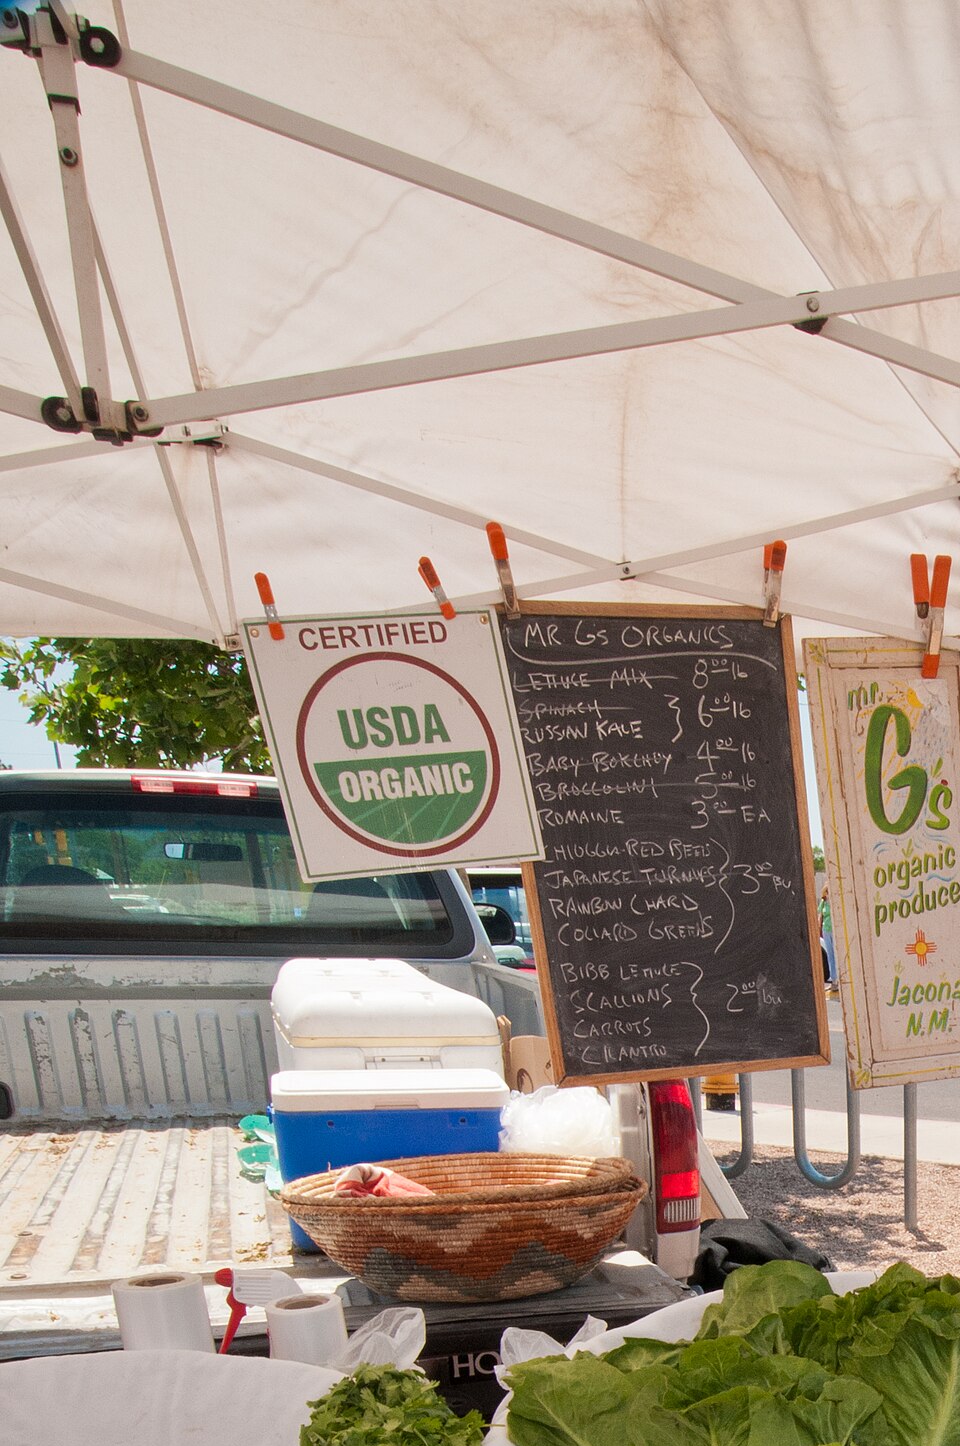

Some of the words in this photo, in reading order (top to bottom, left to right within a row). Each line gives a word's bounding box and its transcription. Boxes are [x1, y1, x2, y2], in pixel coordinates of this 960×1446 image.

[299, 621, 447, 650] CERTIFIED
[525, 623, 561, 648] MR
[621, 626, 734, 649] ORGANICS
[610, 667, 653, 689] MIX
[337, 703, 451, 750] USDA
[596, 720, 643, 741] KALE
[338, 762, 475, 803] ORGANIC
[537, 808, 625, 831] ROMAINE
[743, 805, 771, 824] EA
[544, 870, 632, 889] JAPANESE
[873, 844, 956, 890] organic
[549, 898, 621, 919] RAINBOW
[630, 893, 699, 915] CHARD
[875, 881, 960, 937] produce
[558, 922, 637, 946] COLLARD
[649, 914, 714, 940] GREENS
[560, 962, 609, 983] BIBB
[570, 983, 672, 1013] SCALLIONS
[573, 1016, 652, 1038] CARROTS
